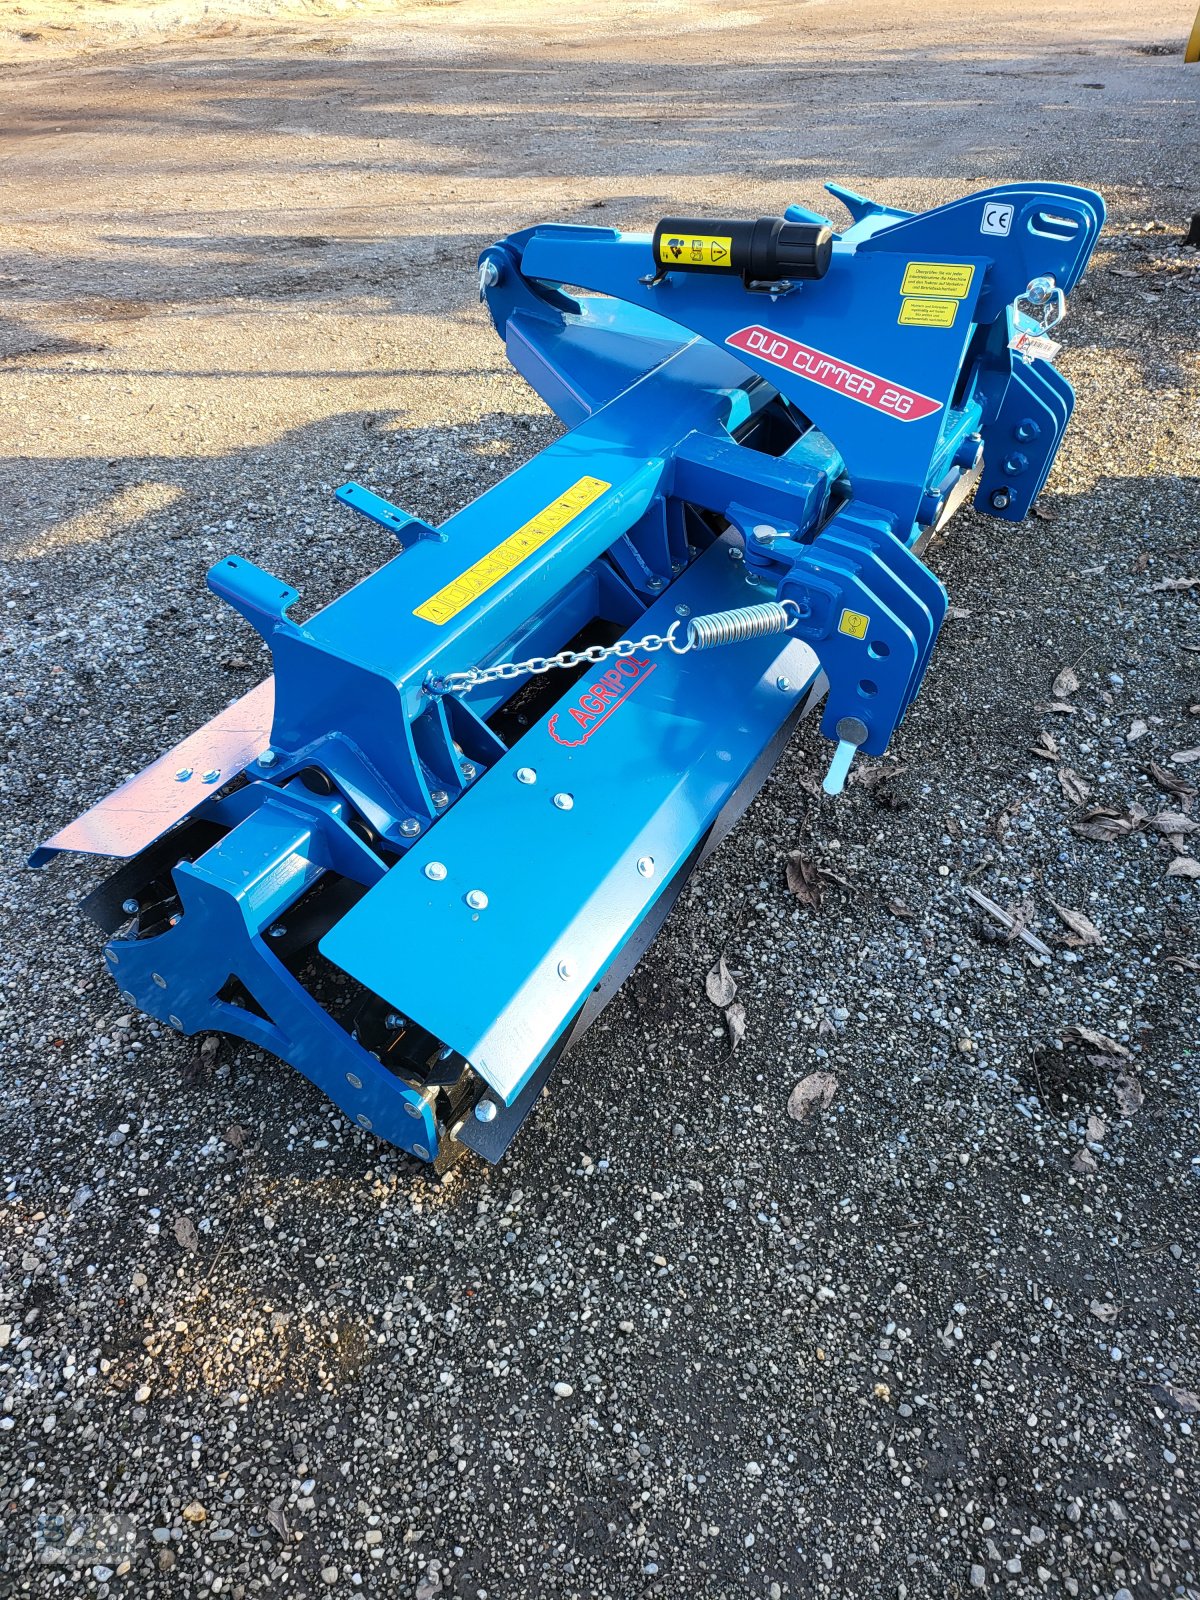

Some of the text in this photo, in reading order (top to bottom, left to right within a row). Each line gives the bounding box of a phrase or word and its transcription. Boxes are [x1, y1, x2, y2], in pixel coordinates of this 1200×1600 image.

[746, 330, 914, 415] DUO CUTTER 2G
[568, 655, 651, 729] AGRIPOL
